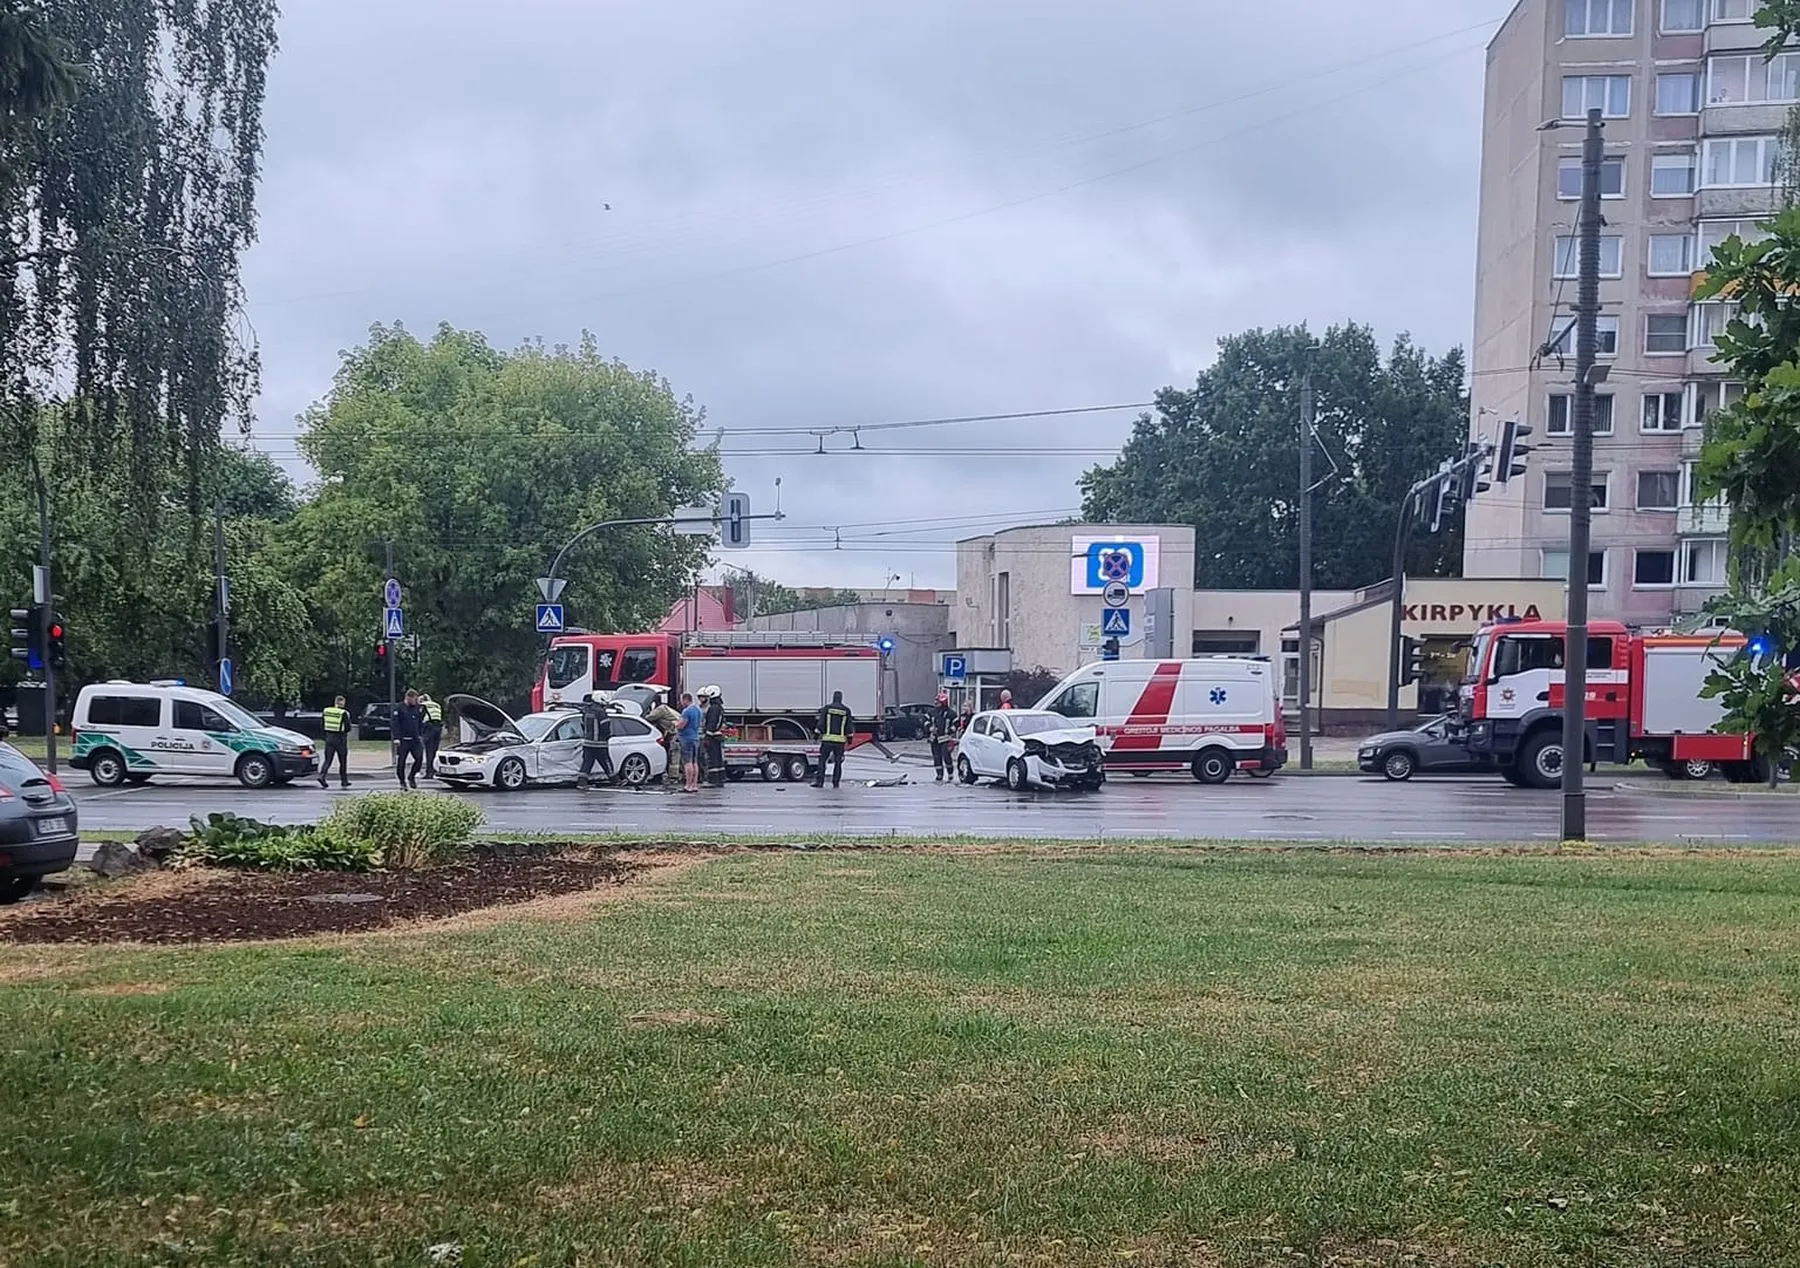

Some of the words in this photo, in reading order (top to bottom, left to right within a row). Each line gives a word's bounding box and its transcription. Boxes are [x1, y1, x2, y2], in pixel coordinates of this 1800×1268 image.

[1401, 604, 1541, 621] KIRPYKLA
[950, 659, 963, 676] P
[1204, 725, 1241, 733] PAGALBA
[151, 741, 195, 750] POLICIJA
